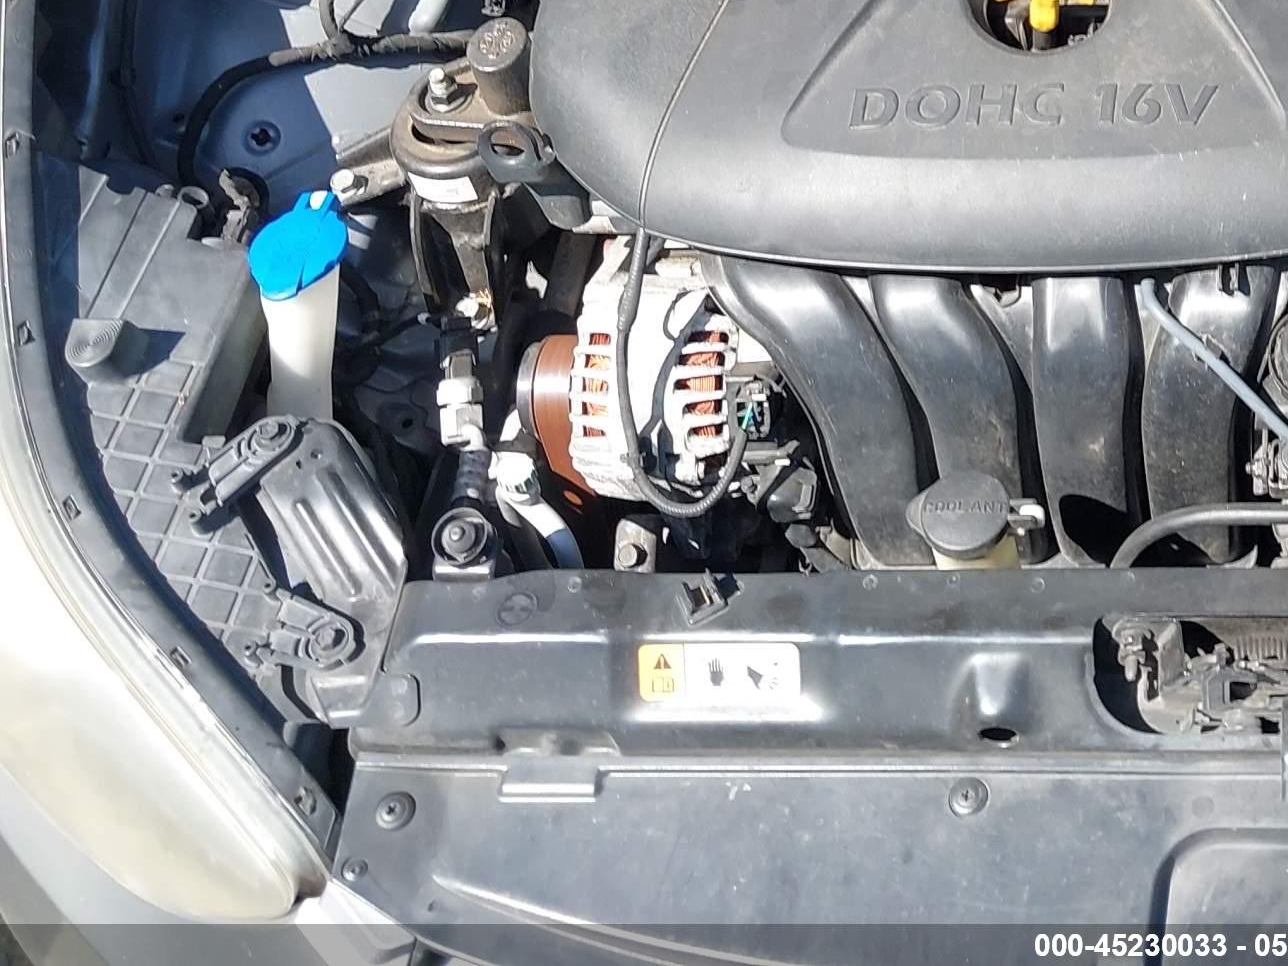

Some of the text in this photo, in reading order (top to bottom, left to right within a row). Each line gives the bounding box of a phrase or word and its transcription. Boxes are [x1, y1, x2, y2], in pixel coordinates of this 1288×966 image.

[849, 82, 1220, 131] DOHC 16V
[924, 499, 1008, 515] COOLANT
